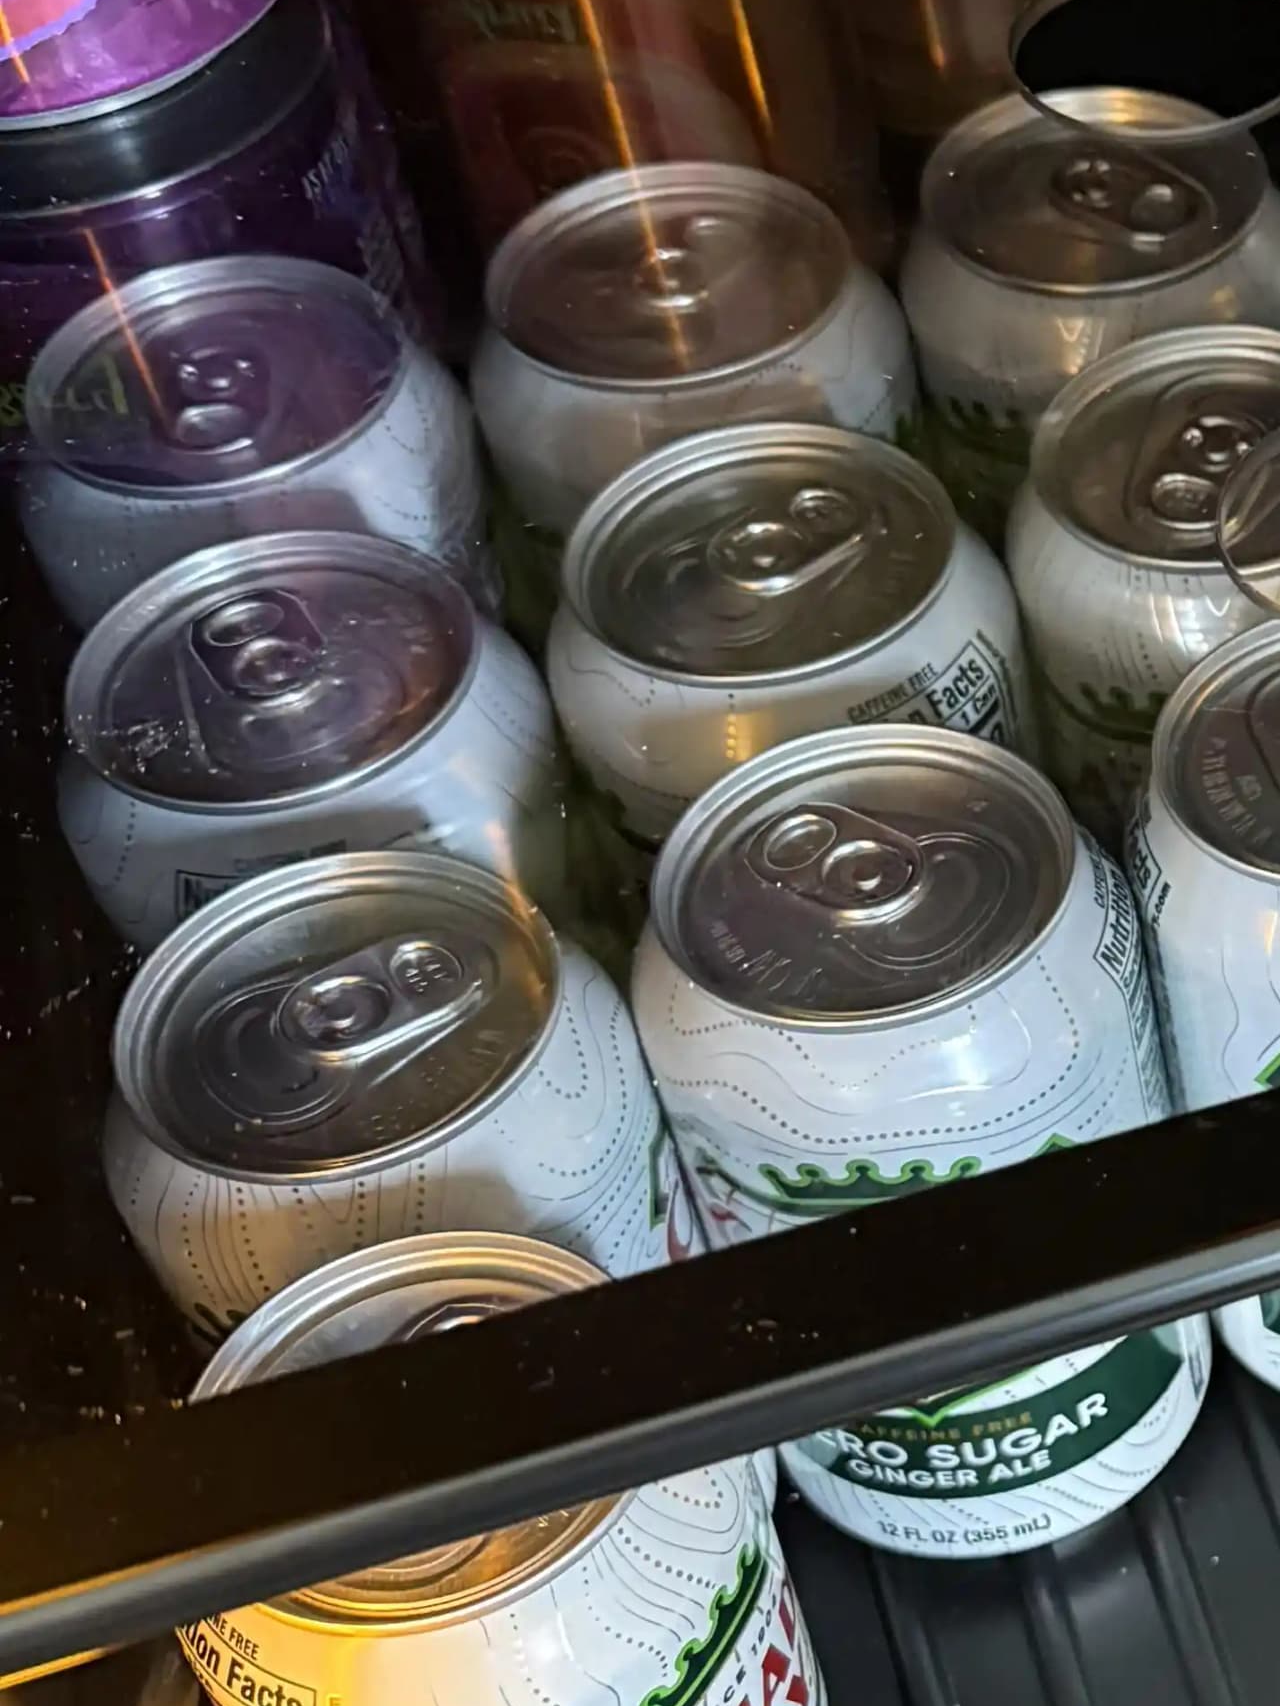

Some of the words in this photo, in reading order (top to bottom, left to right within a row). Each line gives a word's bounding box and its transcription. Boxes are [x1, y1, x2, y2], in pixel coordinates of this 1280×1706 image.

[847, 681, 911, 723] CAFFEINE
[908, 662, 939, 692] FREE
[925, 657, 985, 720] Facts
[959, 710, 971, 727] 1
[1100, 868, 1131, 975] Nutrition
[817, 1426, 909, 1468] ERO
[925, 1392, 1109, 1470] SUGAR
[859, 1423, 962, 1441] AFFEINE
[971, 1410, 1034, 1438] FREE
[847, 1458, 979, 1490] GINGER
[987, 1449, 1052, 1484] ALE
[879, 1519, 900, 1539] 12
[902, 1526, 928, 1543] FL
[931, 1527, 957, 1544] OZ
[962, 1524, 1009, 1545] (355
[228, 1625, 260, 1662] FREE
